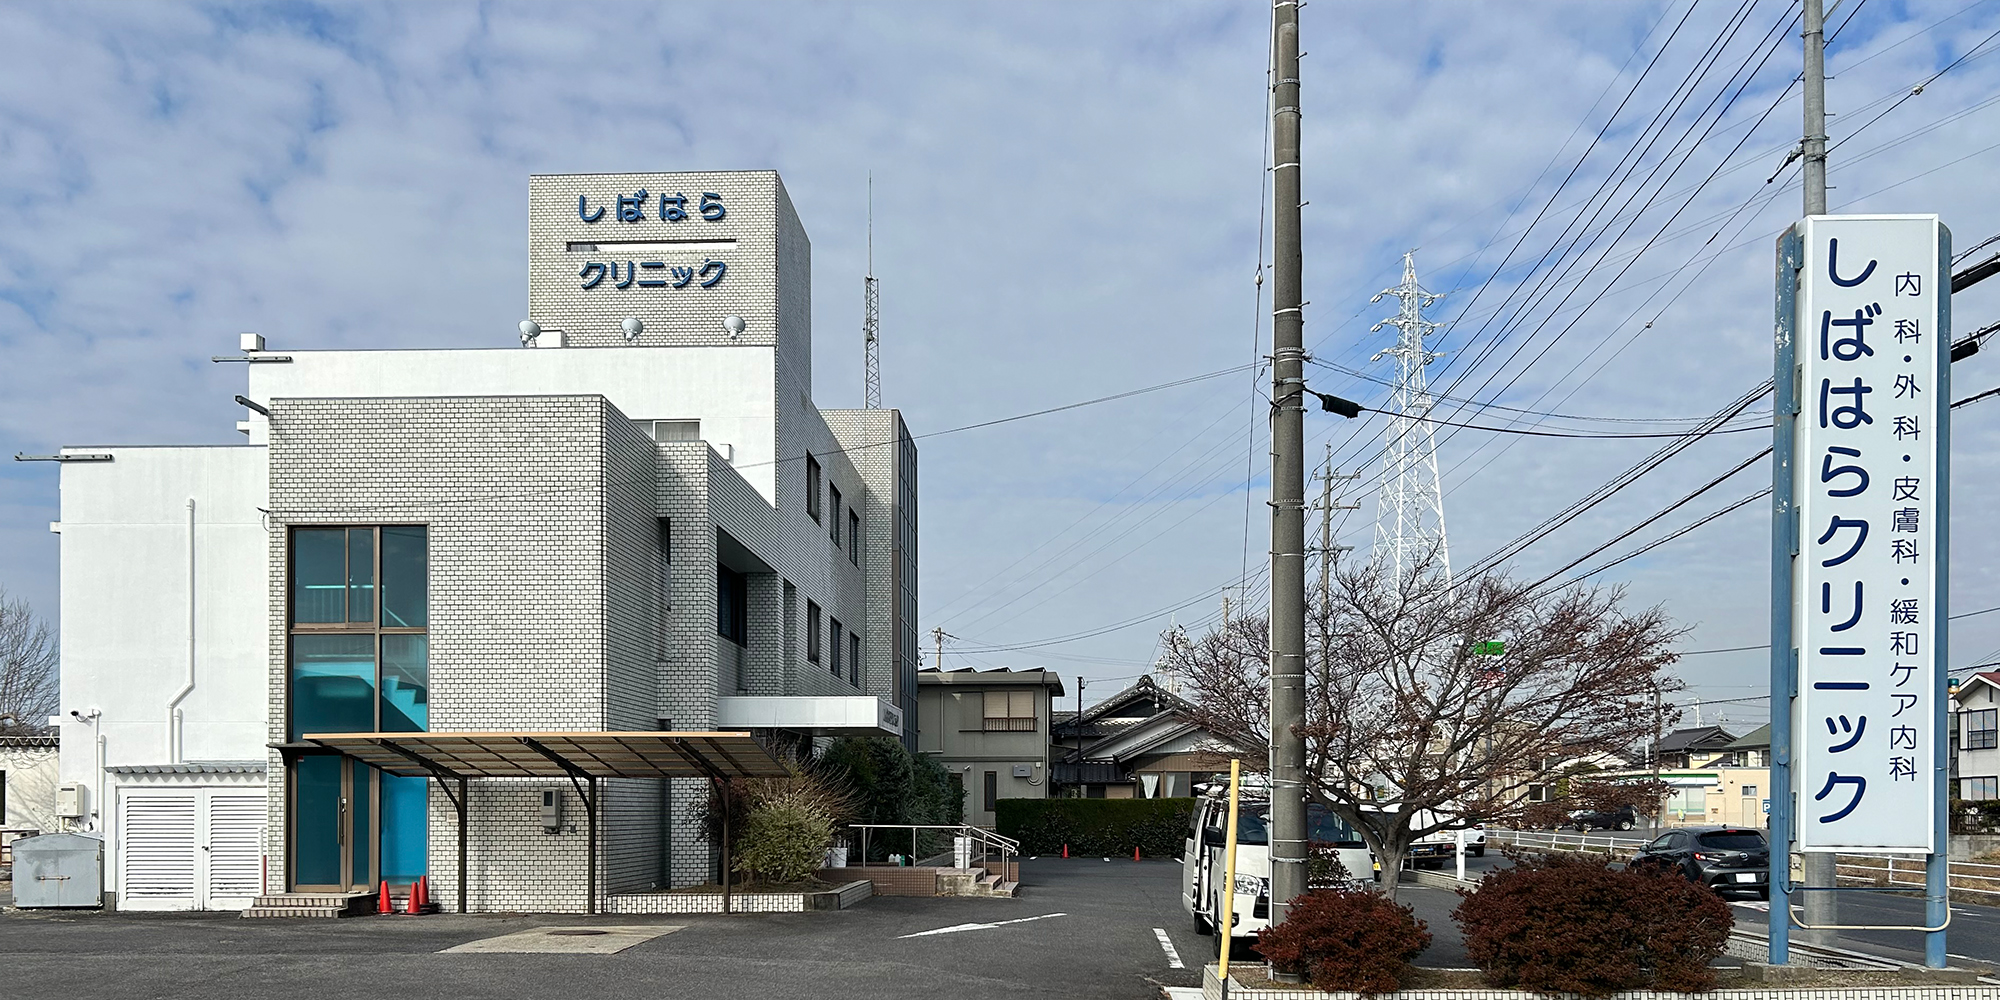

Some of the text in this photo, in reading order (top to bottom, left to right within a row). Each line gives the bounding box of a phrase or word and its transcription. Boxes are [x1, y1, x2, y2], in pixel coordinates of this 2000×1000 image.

[579, 188, 726, 222] しばはら
[579, 258, 726, 289] クリニック
[1813, 237, 1883, 824] しばはらクリニック
[1888, 271, 1922, 782] 内科・外科・皮膚科・緩和ケア内科
[1763, 803, 1771, 811] P
